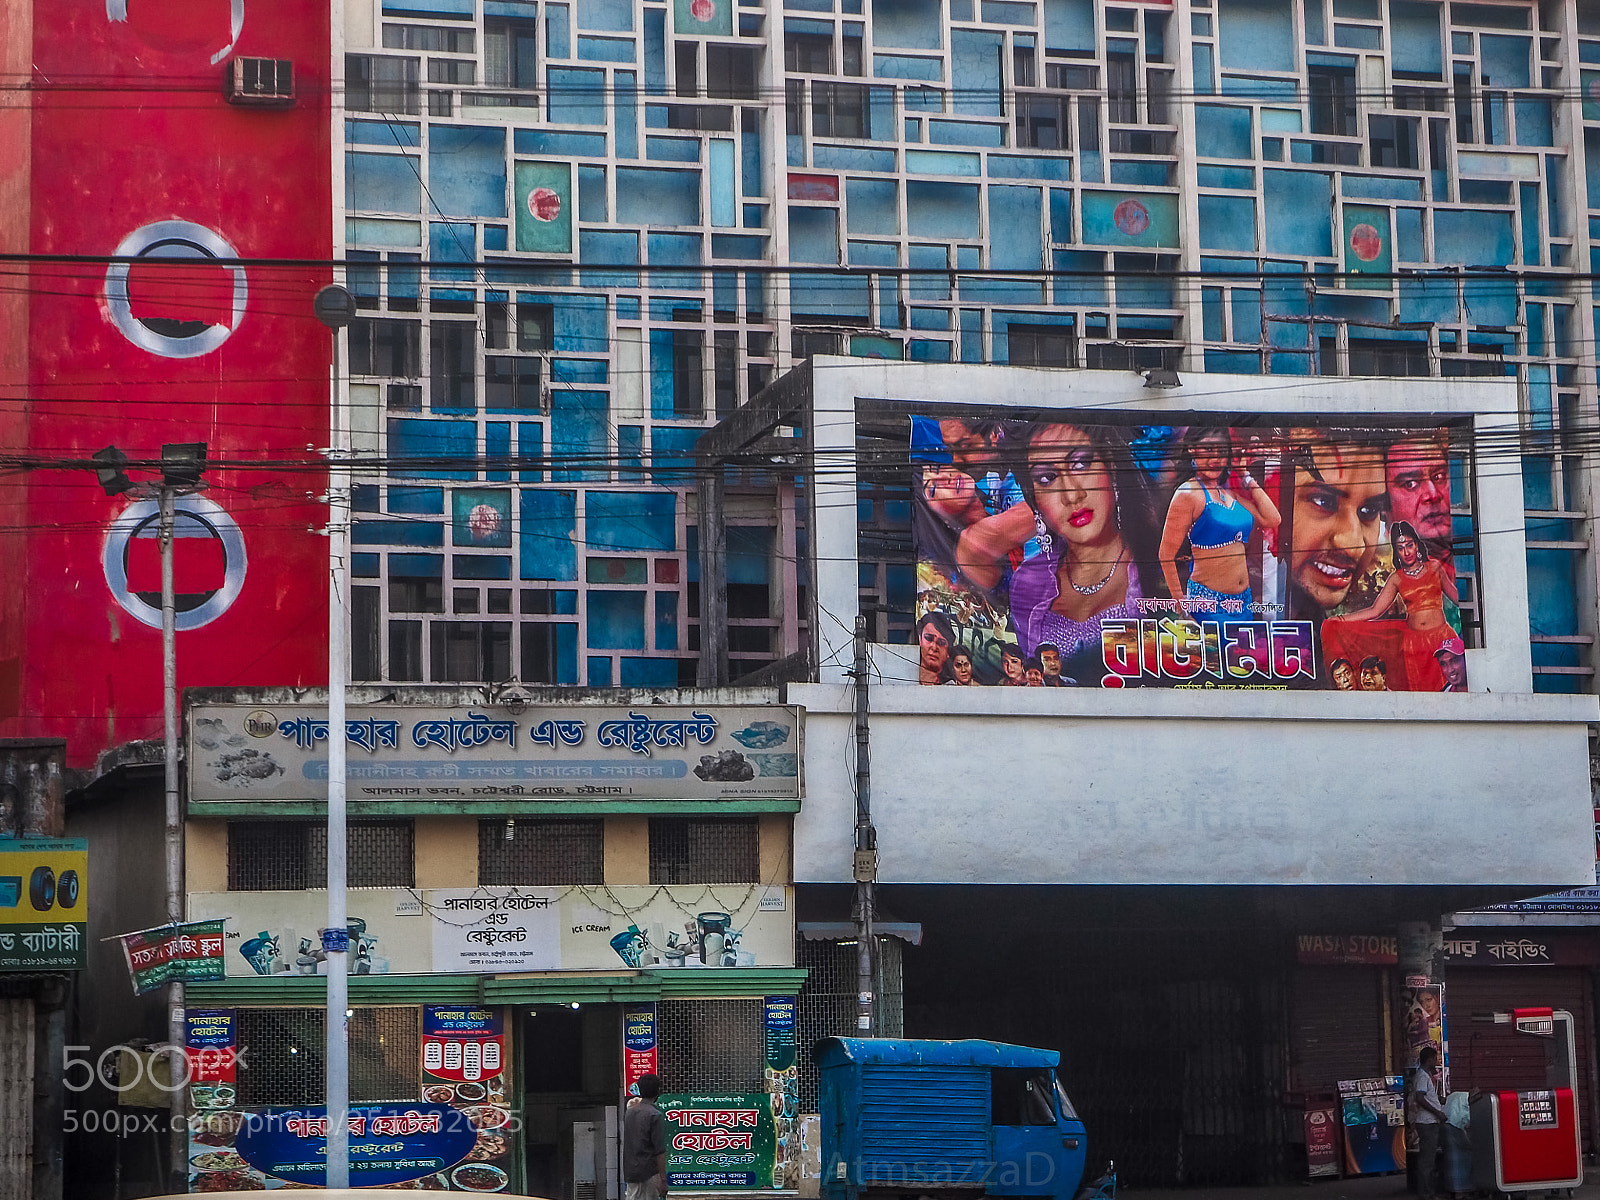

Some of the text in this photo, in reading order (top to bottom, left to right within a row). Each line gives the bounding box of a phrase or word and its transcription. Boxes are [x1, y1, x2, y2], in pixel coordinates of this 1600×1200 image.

[1179, 597, 1219, 615] জাকির
[1221, 598, 1244, 613] খান
[278, 716, 399, 751] পানহার
[411, 711, 517, 751] হোটেল
[361, 786, 420, 796] আলমাস
[443, 894, 549, 911] পানাহার হোটেল
[20, 924, 81, 952] ব্যাটারী
[585, 925, 611, 933] CREAM
[1349, 936, 1397, 956] STORE
[372, 1110, 440, 1136] হোটেল
[665, 1109, 759, 1128] পানাহার
[673, 1128, 753, 1151] হোটেল
